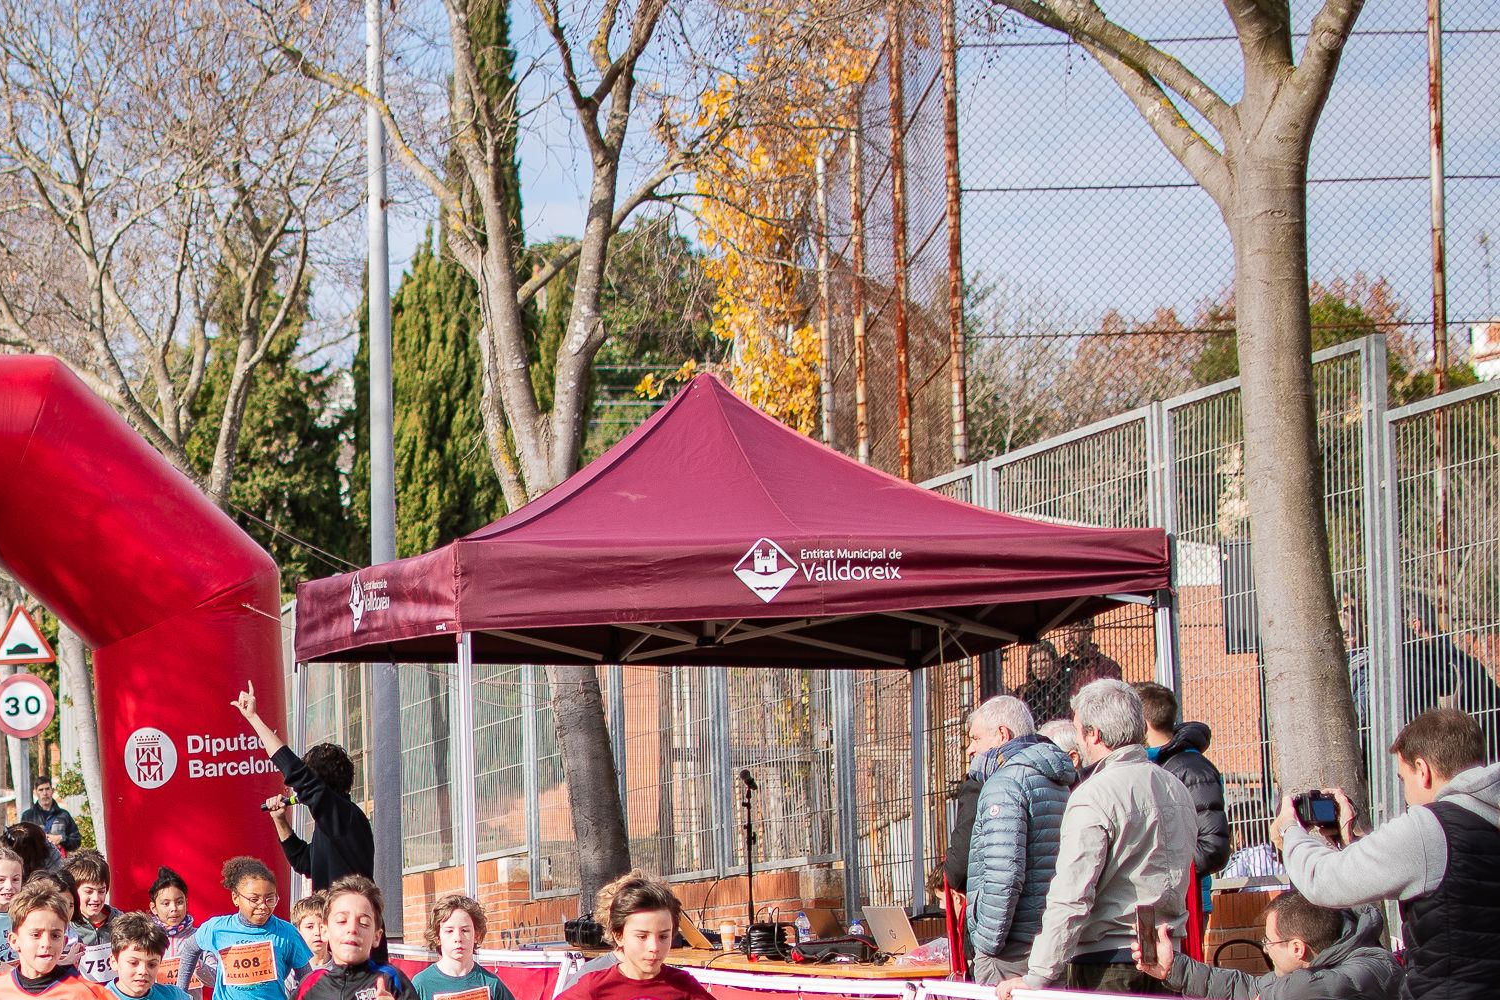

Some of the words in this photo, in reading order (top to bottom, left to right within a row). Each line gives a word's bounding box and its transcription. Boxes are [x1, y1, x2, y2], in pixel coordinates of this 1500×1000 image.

[800, 549, 835, 560] Entitat
[837, 548, 887, 562] Municipal
[889, 549, 903, 560] de
[801, 560, 902, 582] Valldoreix
[5, 695, 41, 717] 30
[233, 956, 261, 969] 408
[252, 969, 273, 977] ITZEL
